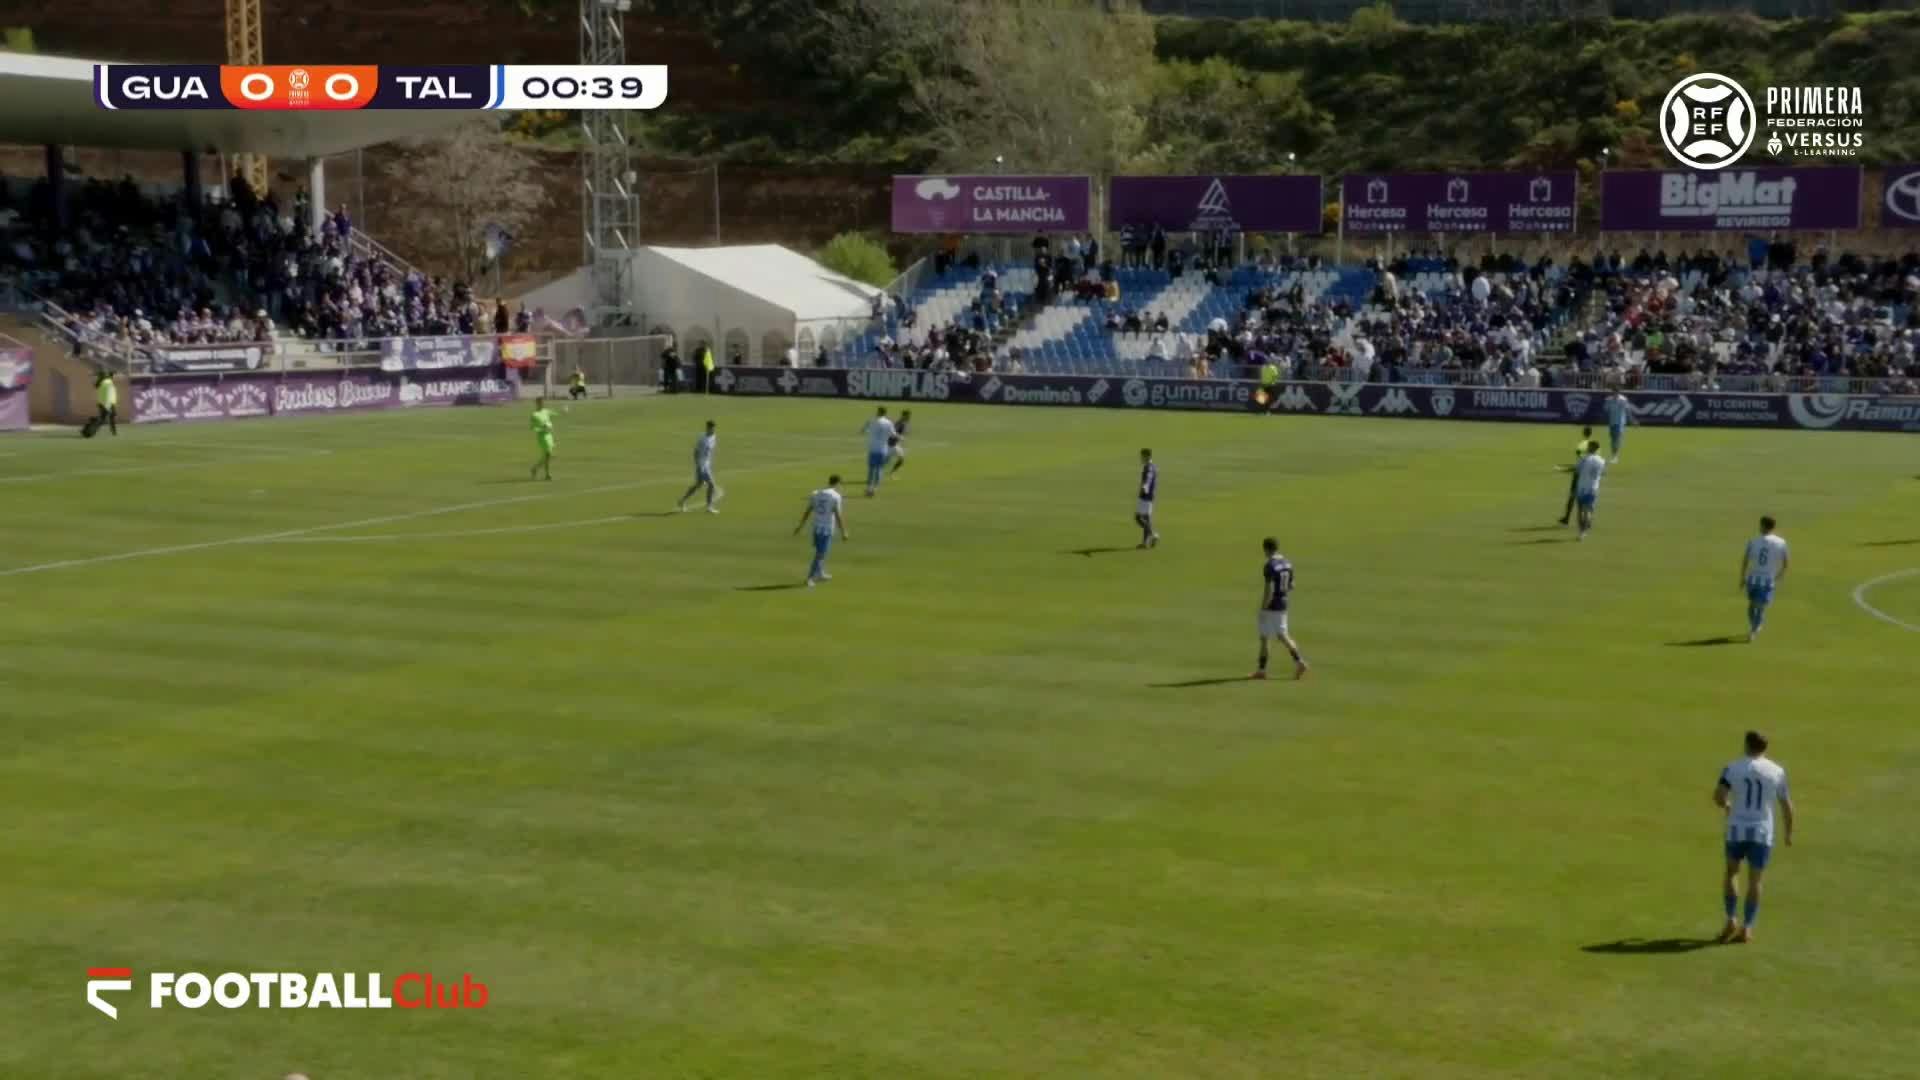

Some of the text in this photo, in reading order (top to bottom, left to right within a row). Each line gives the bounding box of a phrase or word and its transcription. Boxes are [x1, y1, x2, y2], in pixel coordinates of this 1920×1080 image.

[973, 186, 1049, 201] CASTILLA-
[1660, 172, 1796, 218] BigMat
[973, 207, 1065, 222] LA MANCHA
[1348, 204, 1406, 219] Hercesa
[1427, 204, 1487, 219] Hercesa
[1508, 203, 1571, 218] Hercesa
[1151, 381, 1248, 406] gumarfe
[1758, 547, 1768, 566] 6
[1744, 778, 1762, 811] 11
